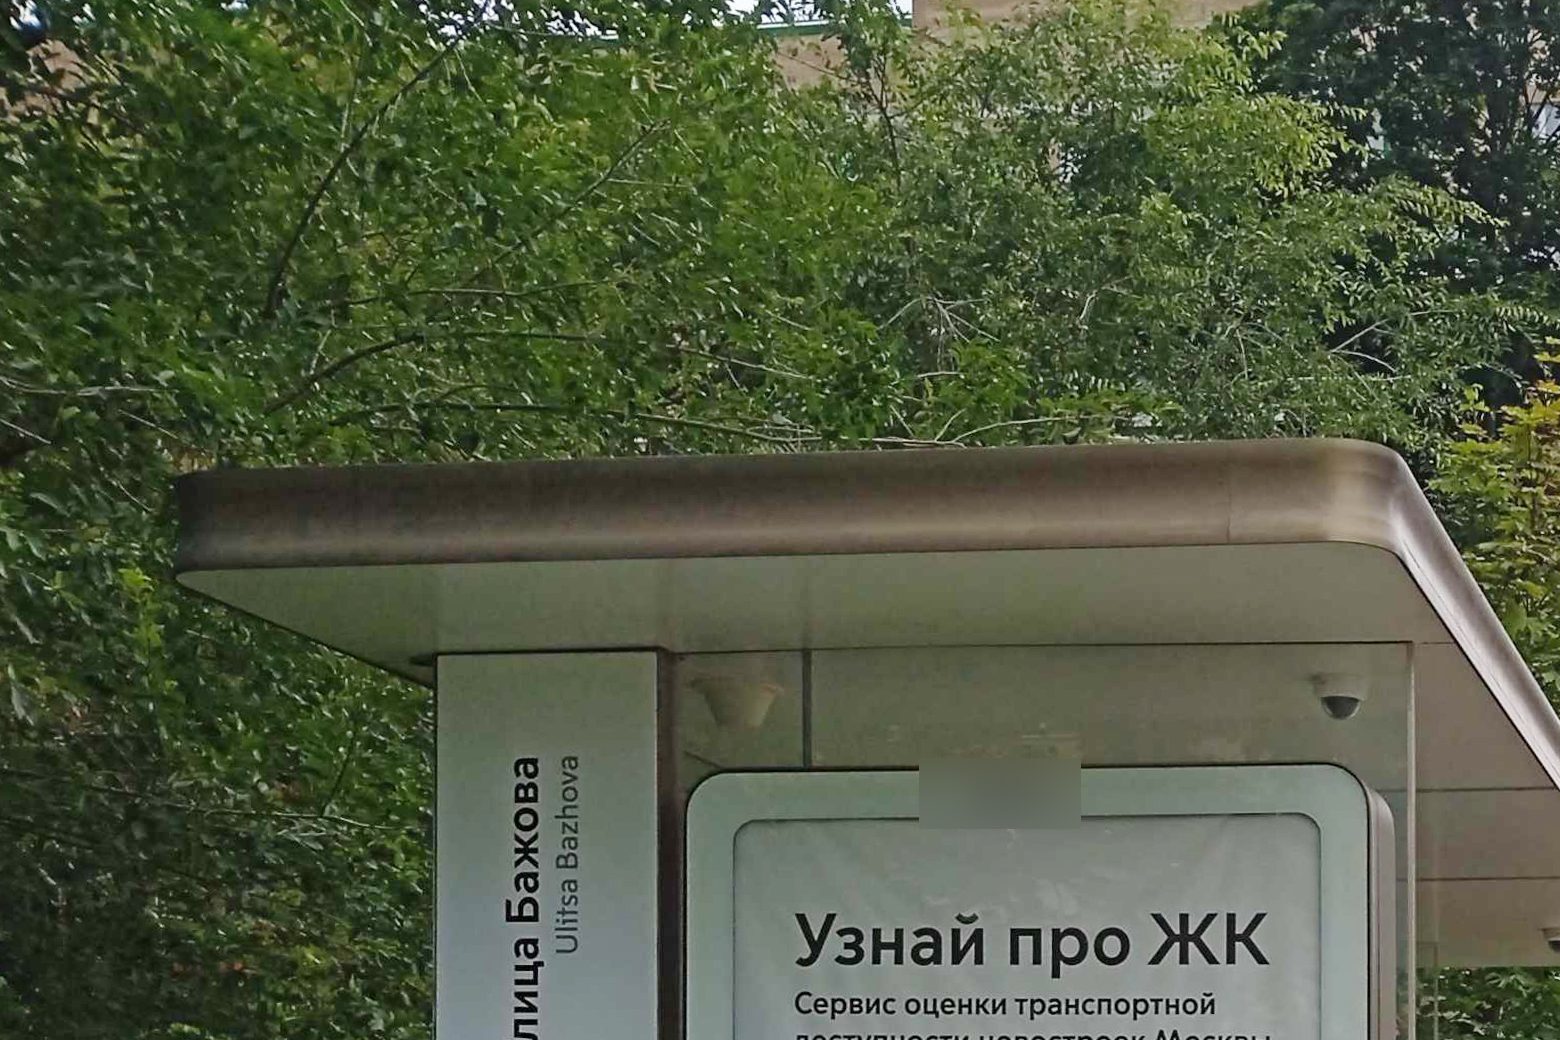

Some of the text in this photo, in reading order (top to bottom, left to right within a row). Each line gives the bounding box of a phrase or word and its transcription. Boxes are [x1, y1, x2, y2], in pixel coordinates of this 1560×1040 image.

[506, 758, 539, 922] Бажова
[554, 756, 578, 953] Ulitsa Bazhova
[795, 913, 1269, 979] Узнай про ЖК
[795, 991, 1214, 1021] Сервис оценки транспортной
